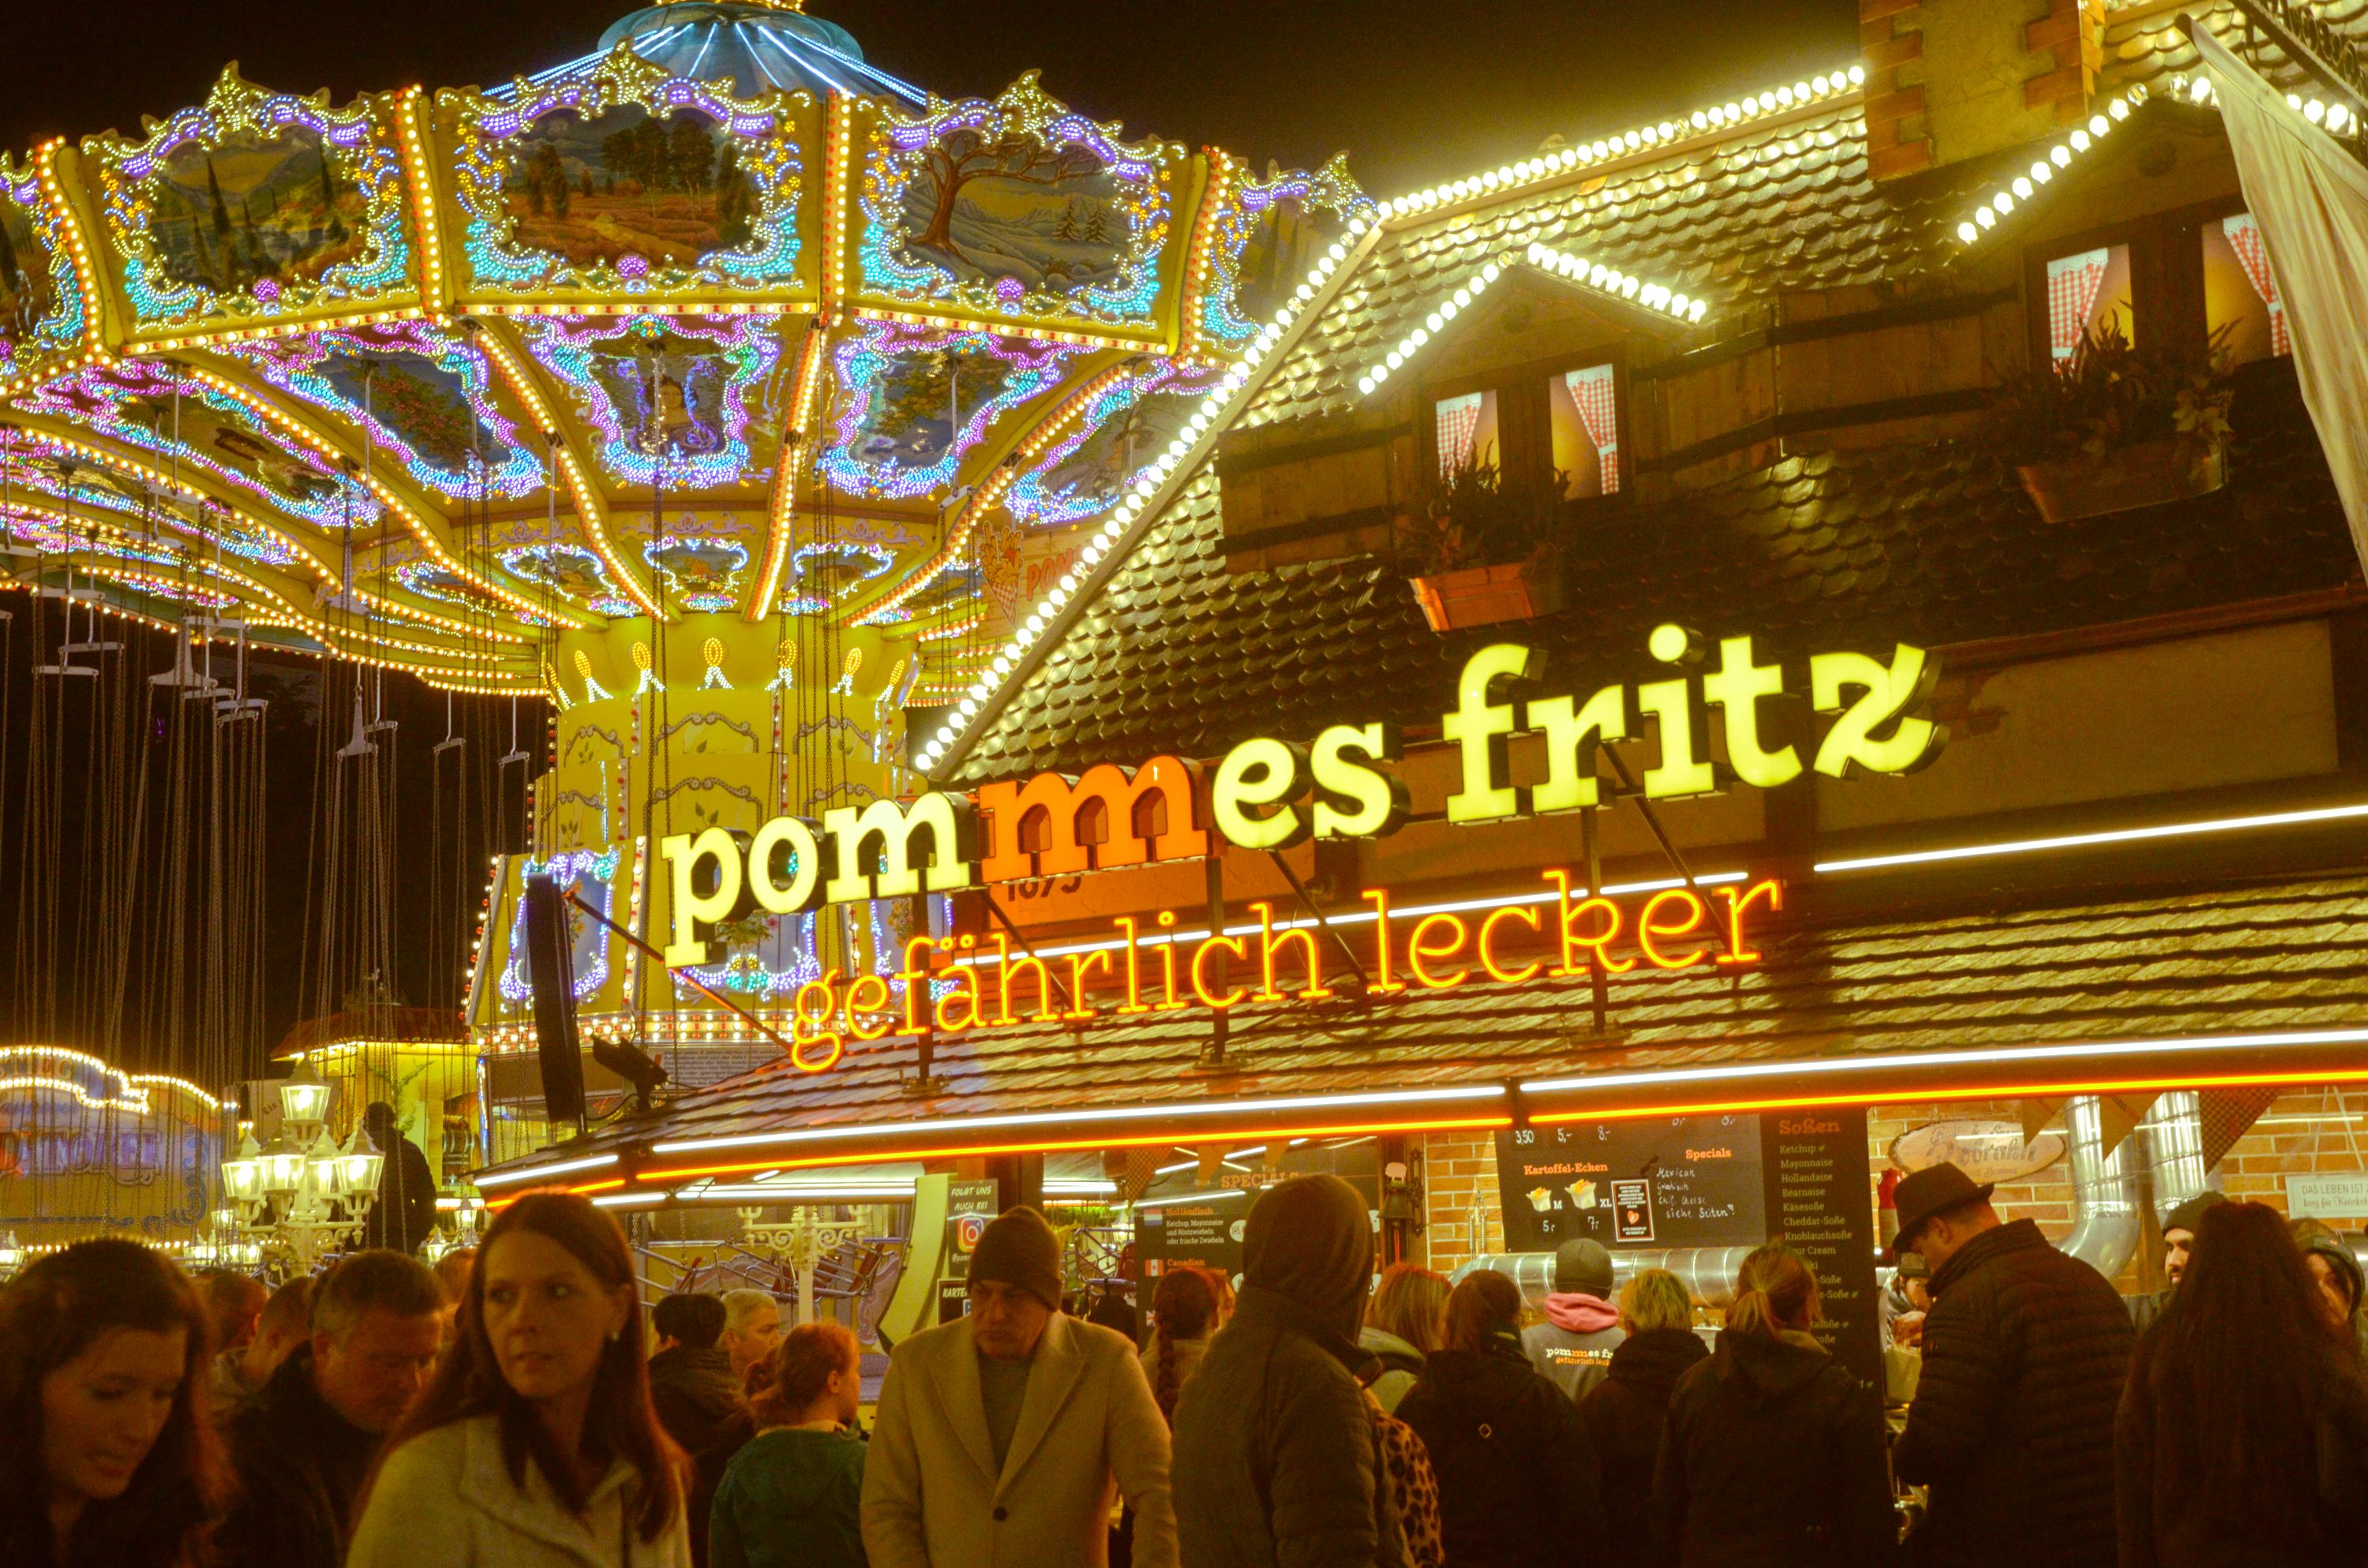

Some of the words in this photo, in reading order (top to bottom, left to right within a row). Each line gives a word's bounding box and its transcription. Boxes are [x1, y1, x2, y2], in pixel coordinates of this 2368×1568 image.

[661, 721, 1392, 968] pommes
[1442, 623, 1934, 824] fritz
[790, 901, 1333, 1072] gefährlich
[1362, 869, 1783, 990] lecker
[1779, 1118, 1841, 1135] Soßen
[1780, 1144, 1816, 1154] Ketchup
[1685, 1147, 1732, 1162] Specials
[1523, 1162, 1609, 1176] Kartoffel-Ecken
[1781, 1159, 1833, 1170] Mayonnaise
[1782, 1173, 1833, 1183] Hollandaise
[951, 1188, 973, 1196] FOLGT
[976, 1186, 991, 1196] UNS
[1782, 1188, 1825, 1197] Béarnaise
[2302, 1184, 2319, 1194] DAS
[2321, 1184, 2348, 1194] LEBEN
[954, 1202, 973, 1211] AUCH
[1553, 1200, 1563, 1210] M
[1599, 1198, 1613, 1208] XL
[1783, 1202, 1824, 1212] Käsesoße
[1784, 1215, 1846, 1226] Cheddar-Soße
[1785, 1231, 1853, 1241] Knoblauchsoße
[1807, 1246, 1836, 1255] Cream
